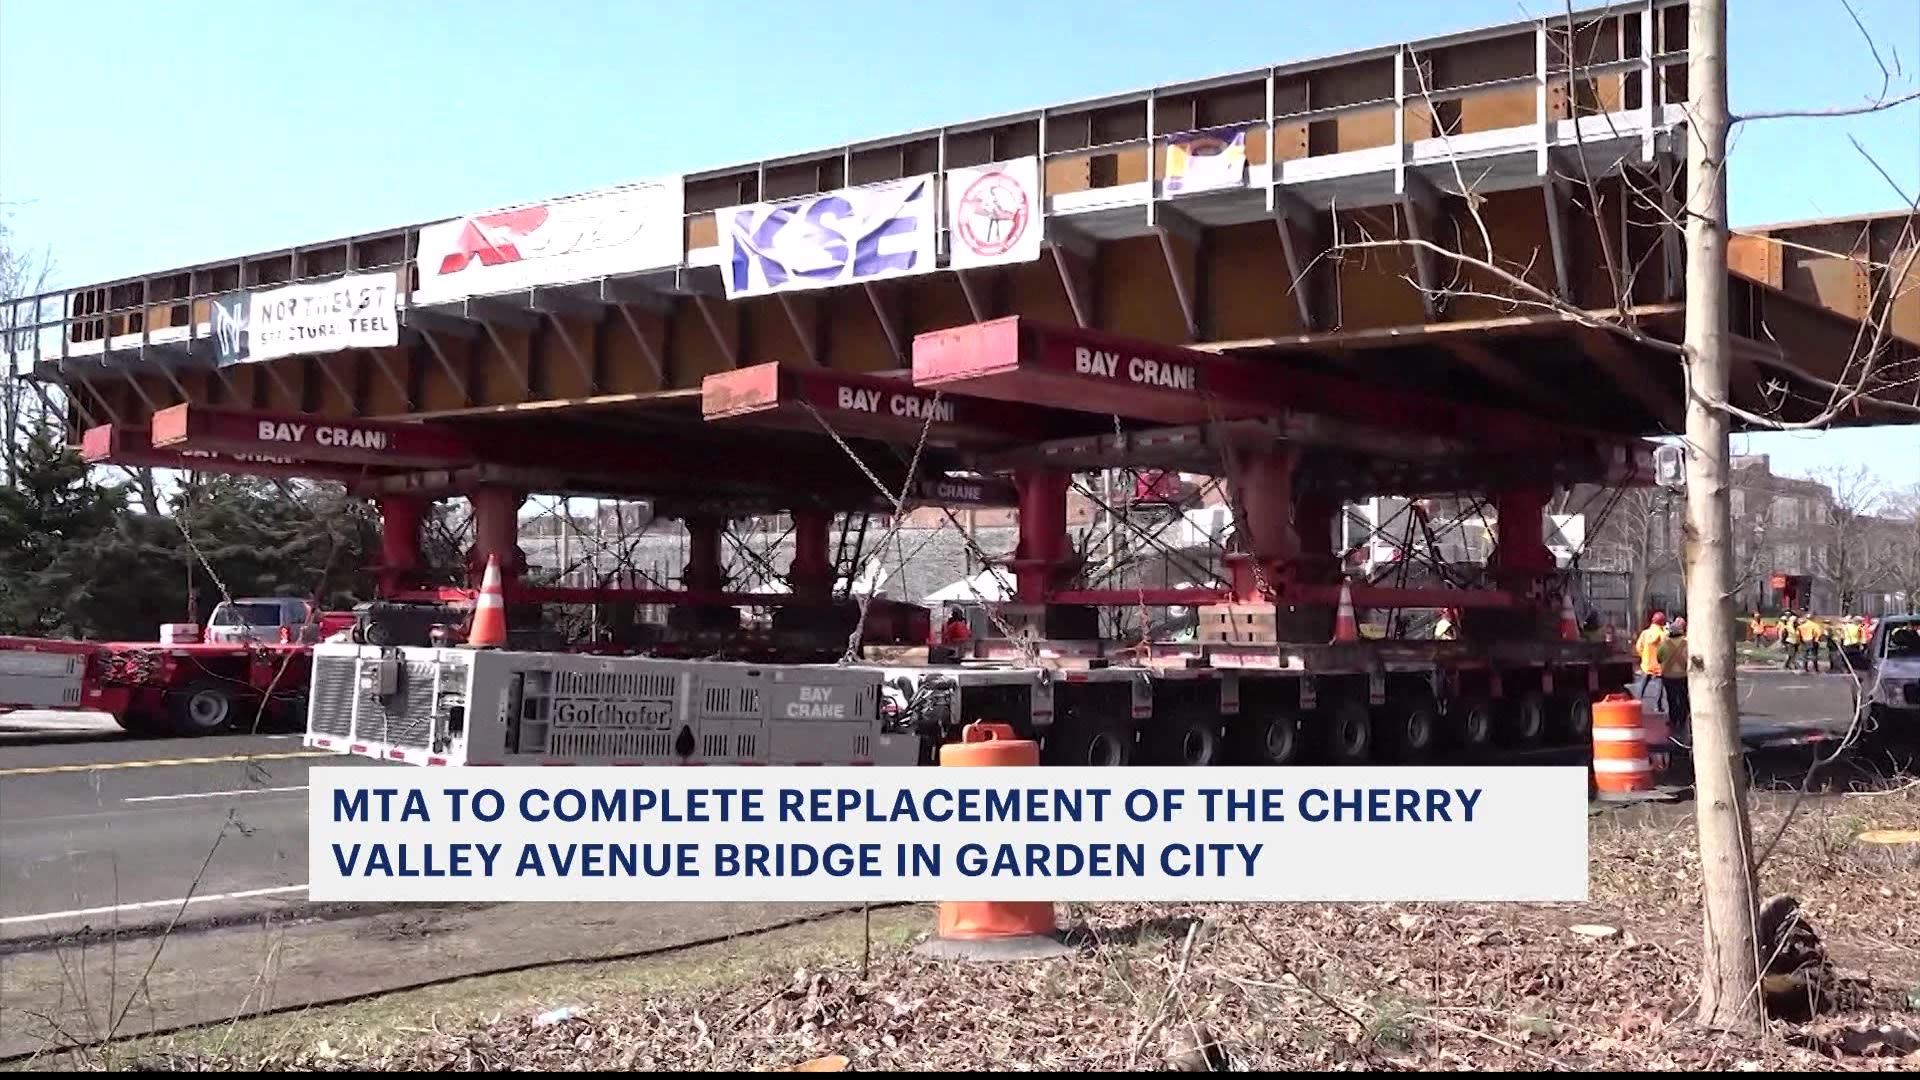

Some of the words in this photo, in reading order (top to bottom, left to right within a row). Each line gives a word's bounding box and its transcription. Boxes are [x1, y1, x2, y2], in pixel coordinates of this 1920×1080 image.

[731, 180, 925, 292] KSE
[1075, 346, 1119, 378] BAY
[838, 386, 881, 413] BAY
[258, 421, 306, 441] BAY
[800, 686, 833, 701] BAY
[558, 703, 668, 724] Goldhofer
[787, 702, 845, 719] CRANE
